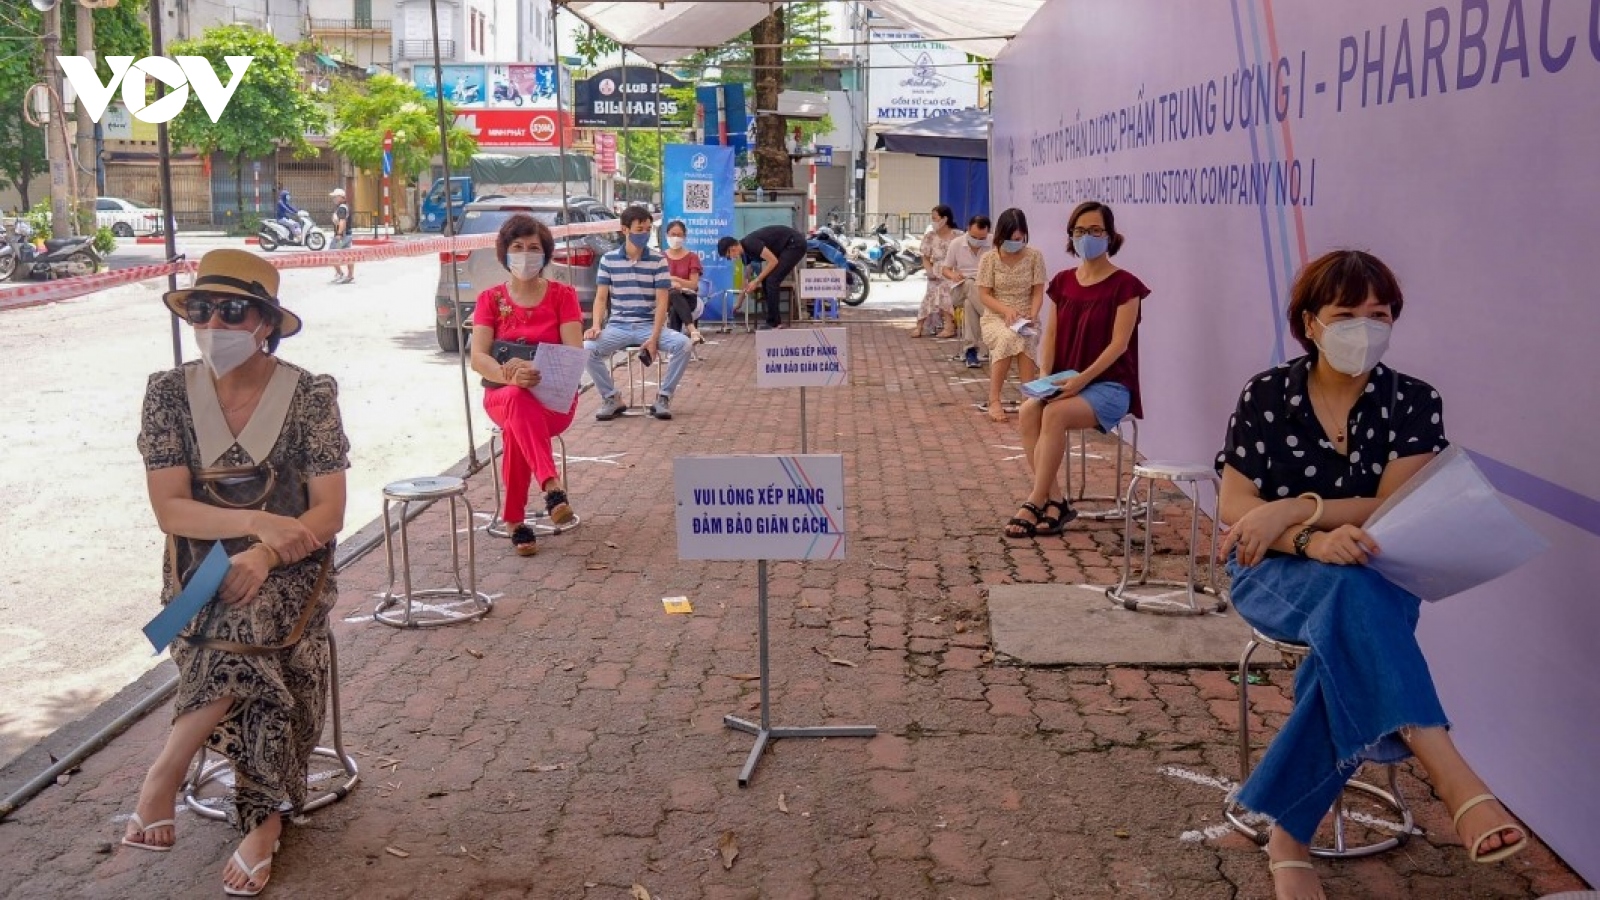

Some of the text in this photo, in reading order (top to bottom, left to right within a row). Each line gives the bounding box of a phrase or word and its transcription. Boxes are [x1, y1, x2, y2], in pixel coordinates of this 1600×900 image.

[878, 107, 919, 118] MINH
[1089, 111, 1117, 163] DƯỢC
[1119, 83, 1155, 150] PHẨM
[1159, 79, 1217, 143] TRUNG
[1222, 56, 1291, 133] ƯƠNG
[1200, 162, 1272, 205] COMPANY
[766, 344, 838, 357] VUI LÒNG XẾP HÀNG
[765, 361, 840, 374] ĐẢM BẢO GIÃN CÁCH
[693, 483, 825, 506] VUI LÒNG XẾP HÀNG
[693, 511, 829, 534] ĐẢM BẢO GIÃN CÁCH
